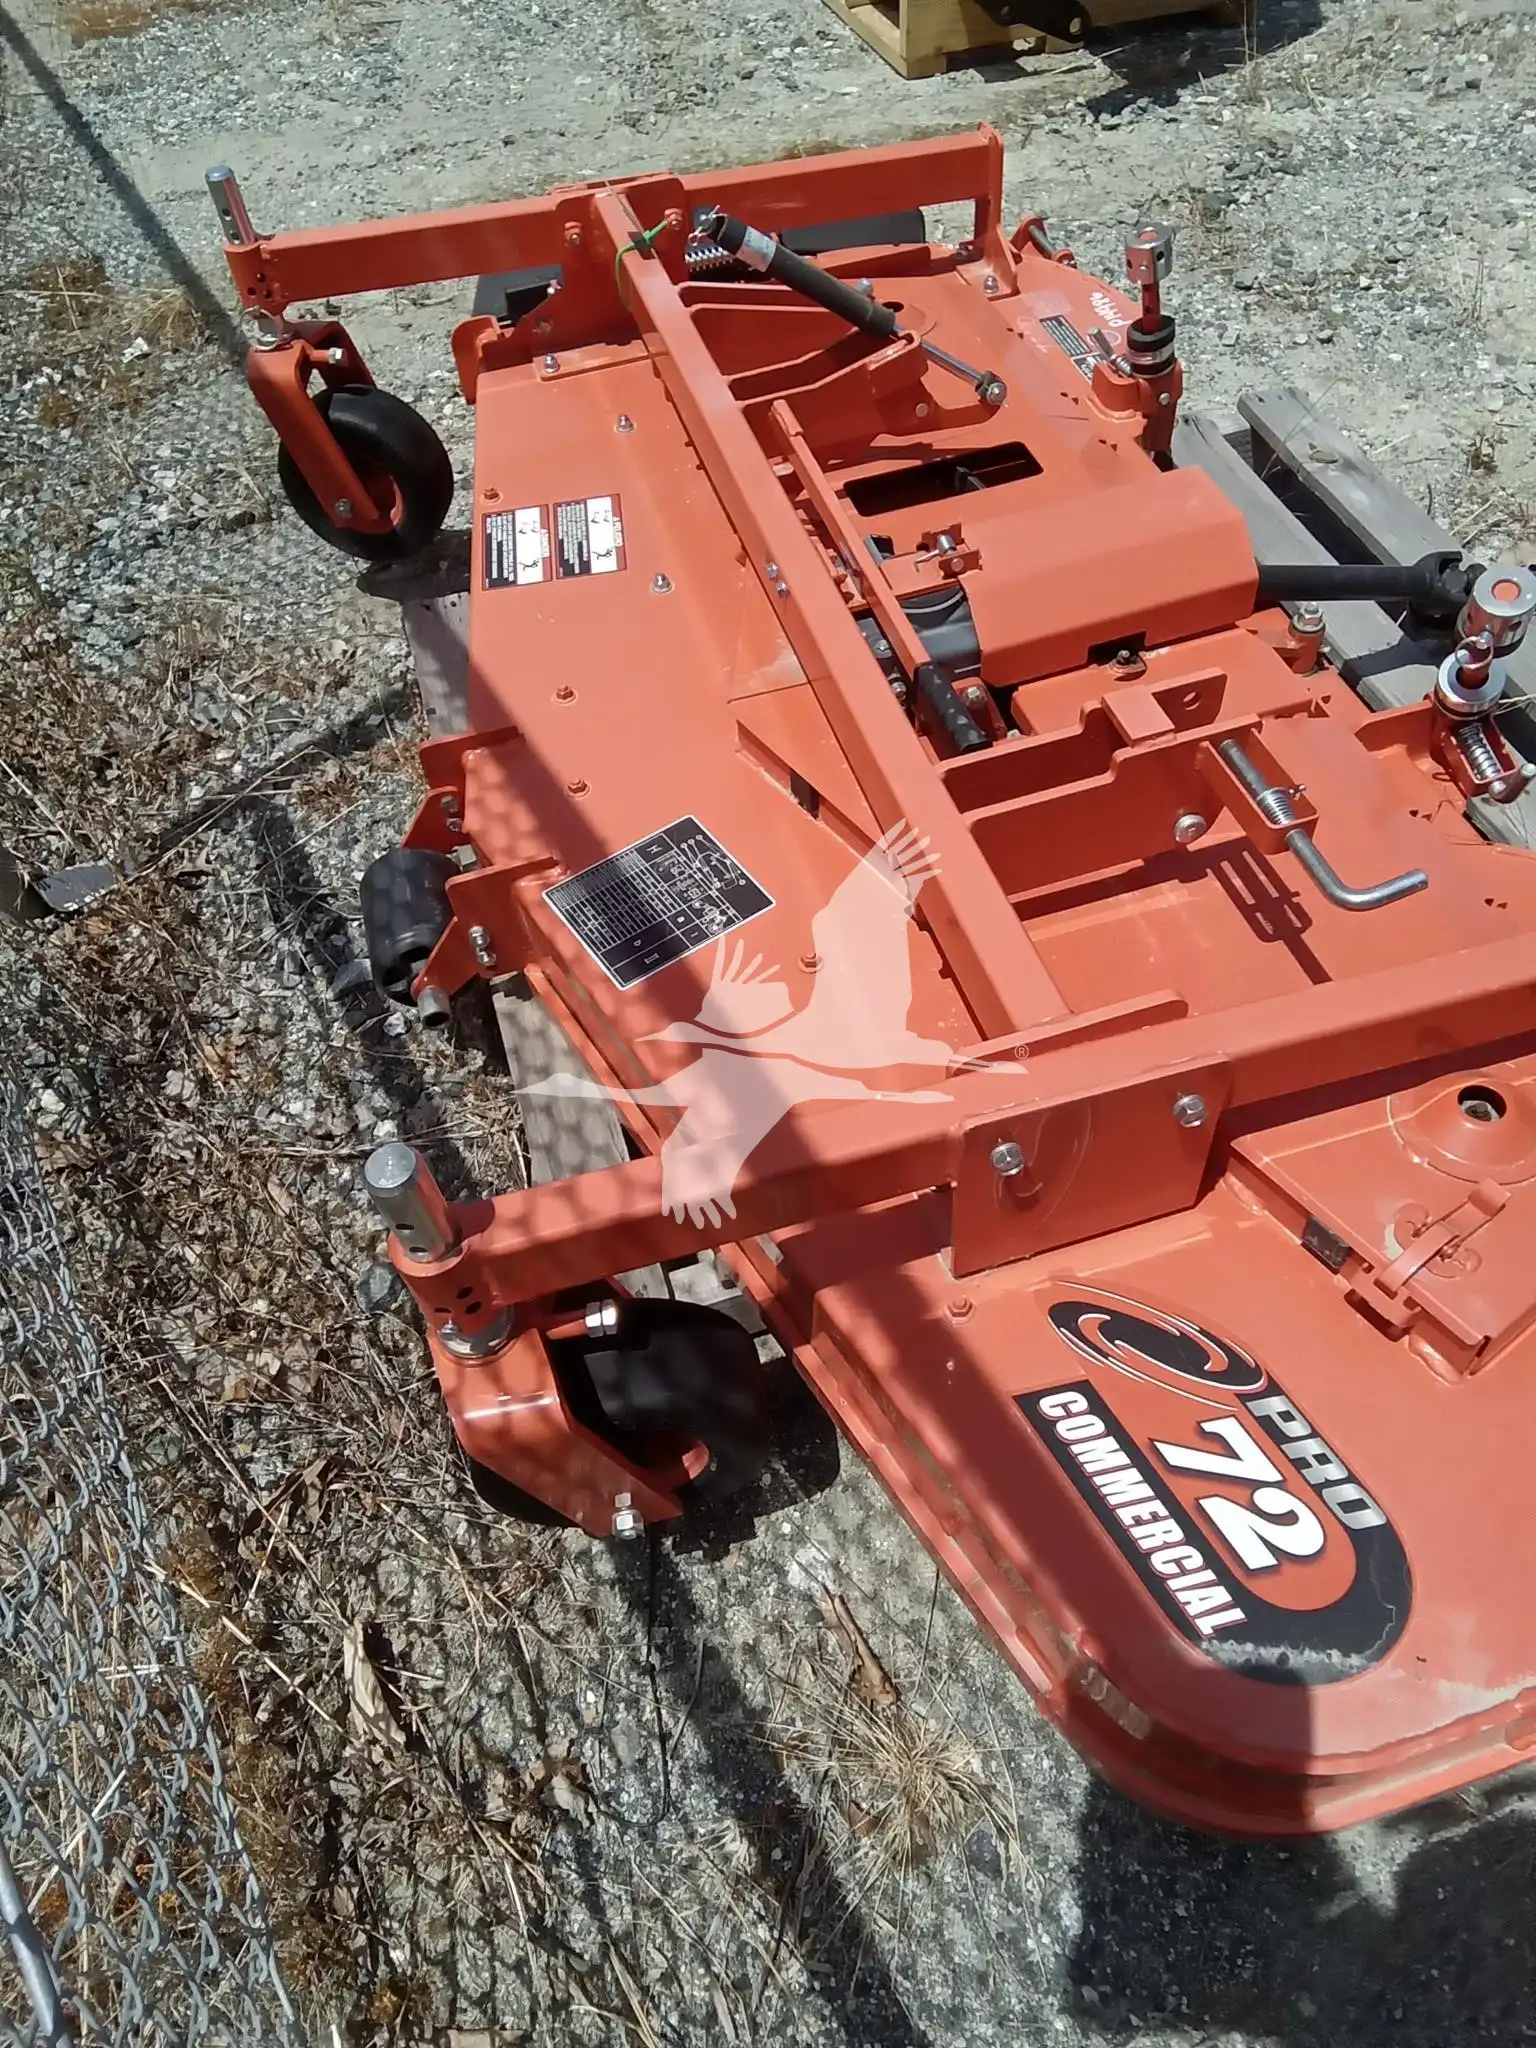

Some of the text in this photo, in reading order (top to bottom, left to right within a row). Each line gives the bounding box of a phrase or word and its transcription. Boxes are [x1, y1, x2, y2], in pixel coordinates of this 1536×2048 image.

[1037, 1390, 1248, 1639] COMMERCIAL
[1148, 1414, 1326, 1570] 72
[1245, 1394, 1388, 1530] PRO
